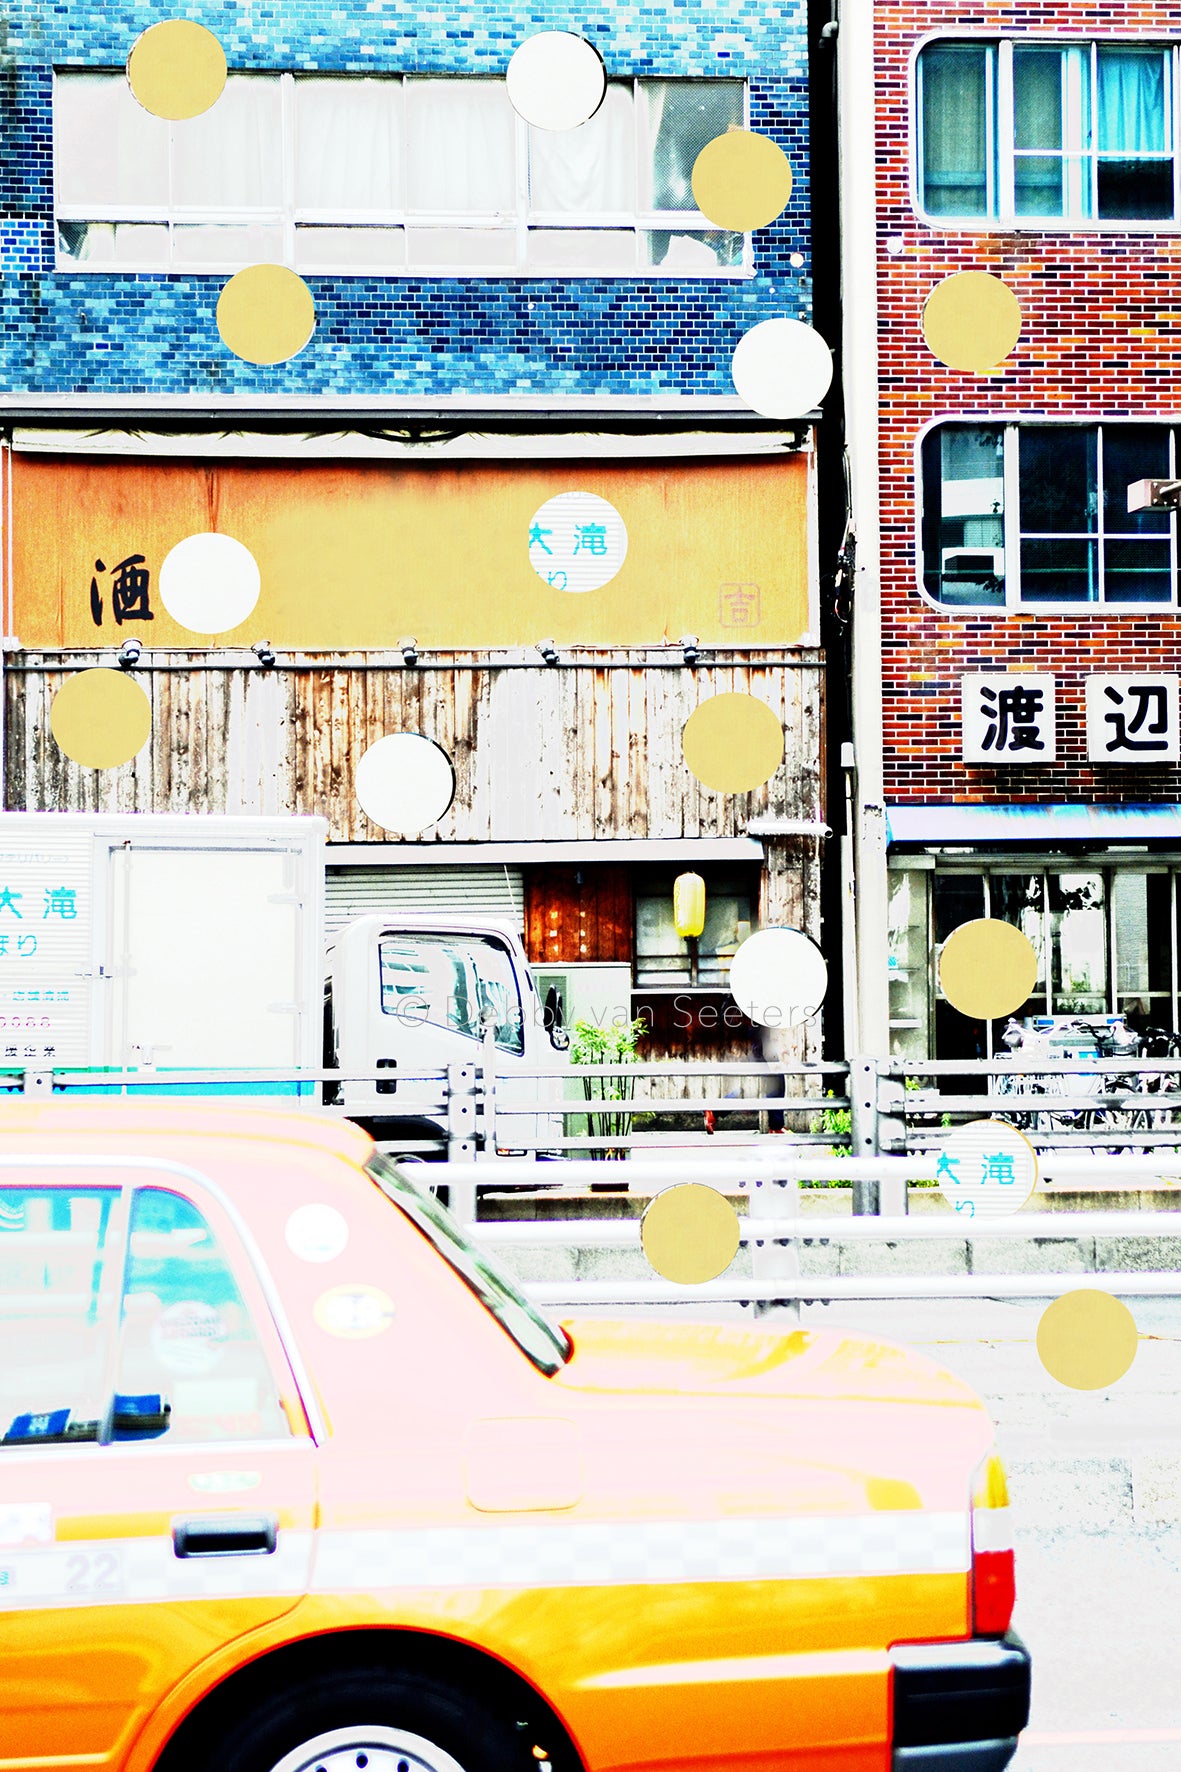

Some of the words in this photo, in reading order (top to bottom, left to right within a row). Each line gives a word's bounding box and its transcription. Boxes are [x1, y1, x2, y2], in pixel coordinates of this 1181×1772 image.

[90, 554, 154, 626] 酒
[980, 685, 1169, 753] 渡辺
[0, 886, 77, 919] 大滝
[65, 1552, 118, 1592] 22
